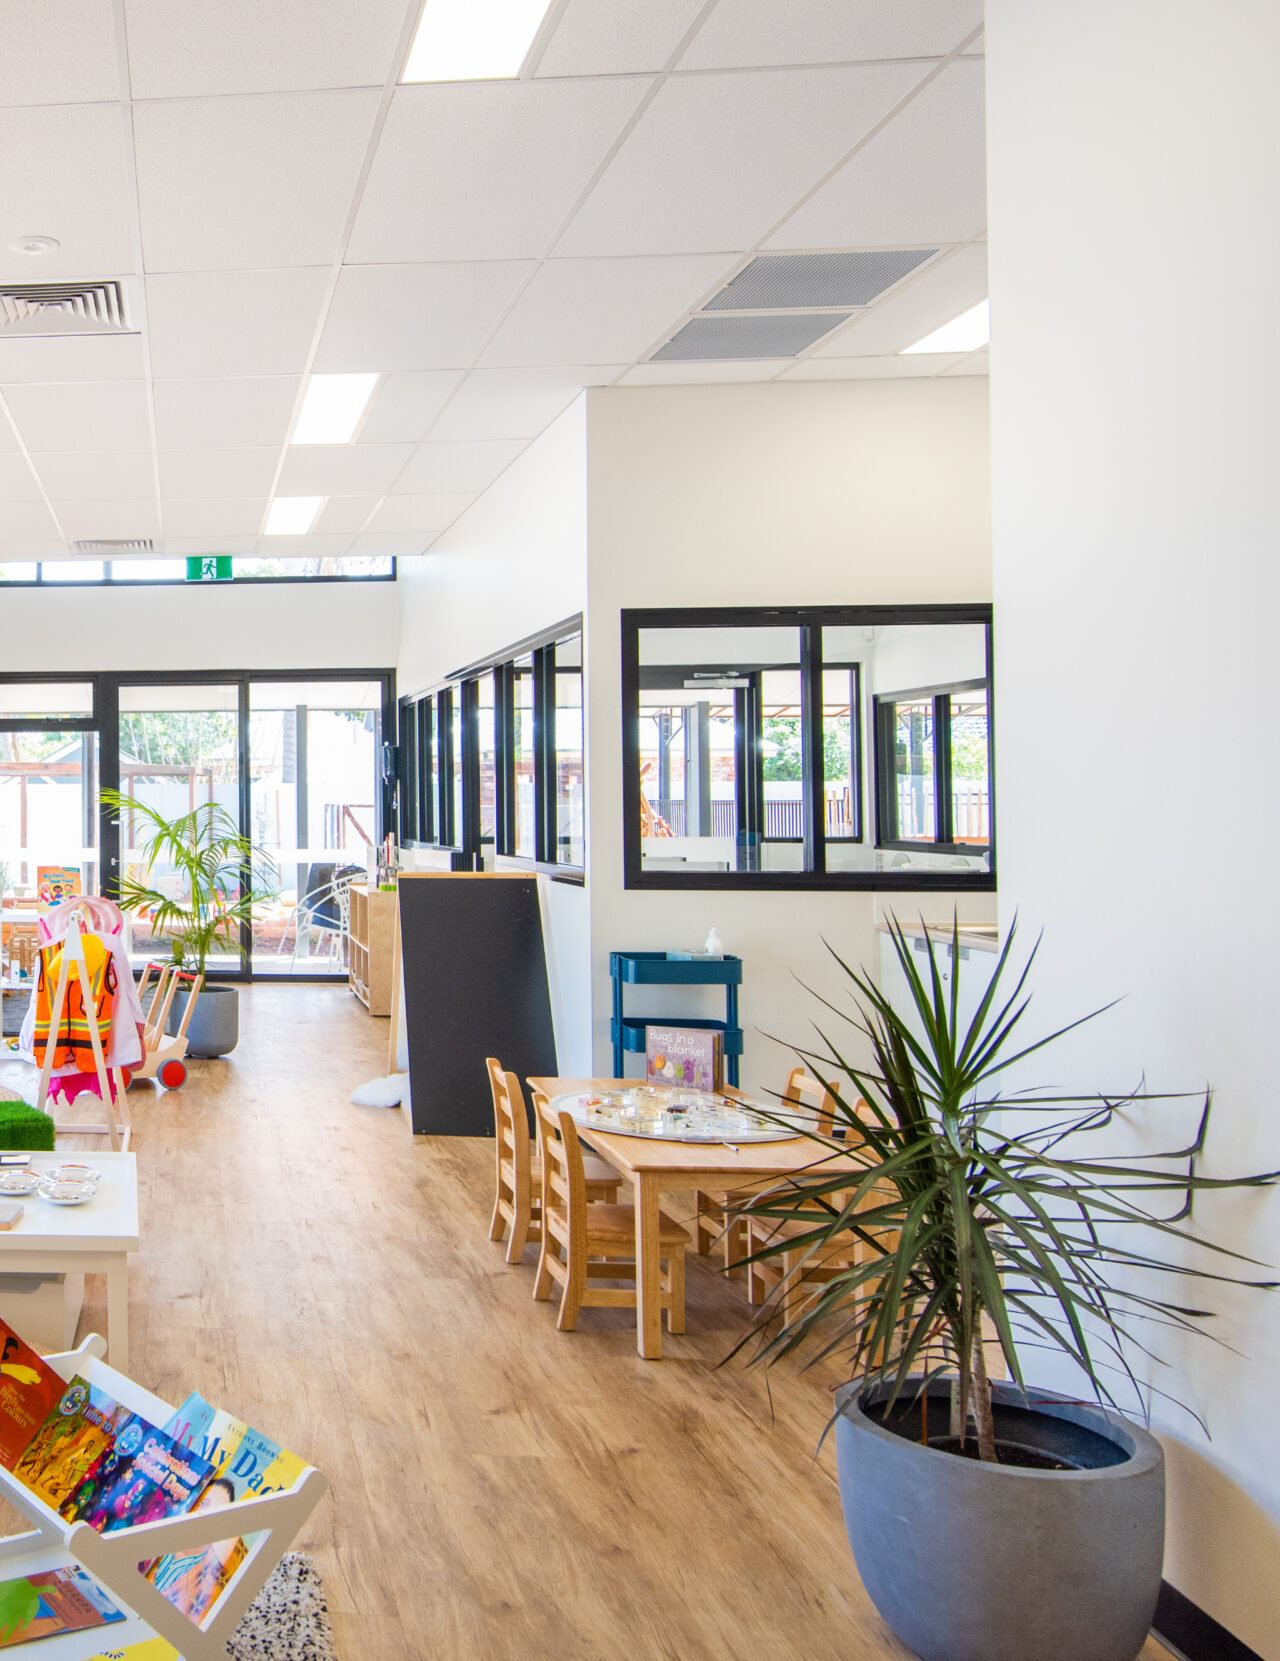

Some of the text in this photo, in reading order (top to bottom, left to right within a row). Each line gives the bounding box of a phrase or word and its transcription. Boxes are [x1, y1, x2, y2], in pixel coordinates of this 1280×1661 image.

[650, 1029, 694, 1045] Bugs in a
[668, 1044, 705, 1058] blanket
[0, 1386, 20, 1406] Birds
[1, 1400, 28, 1428] Colours
[82, 1405, 102, 1425] Time
[101, 1419, 113, 1432] to
[144, 1438, 201, 1486] Celebrations
[202, 1435, 232, 1466] My
[132, 1452, 190, 1501] Special Days
